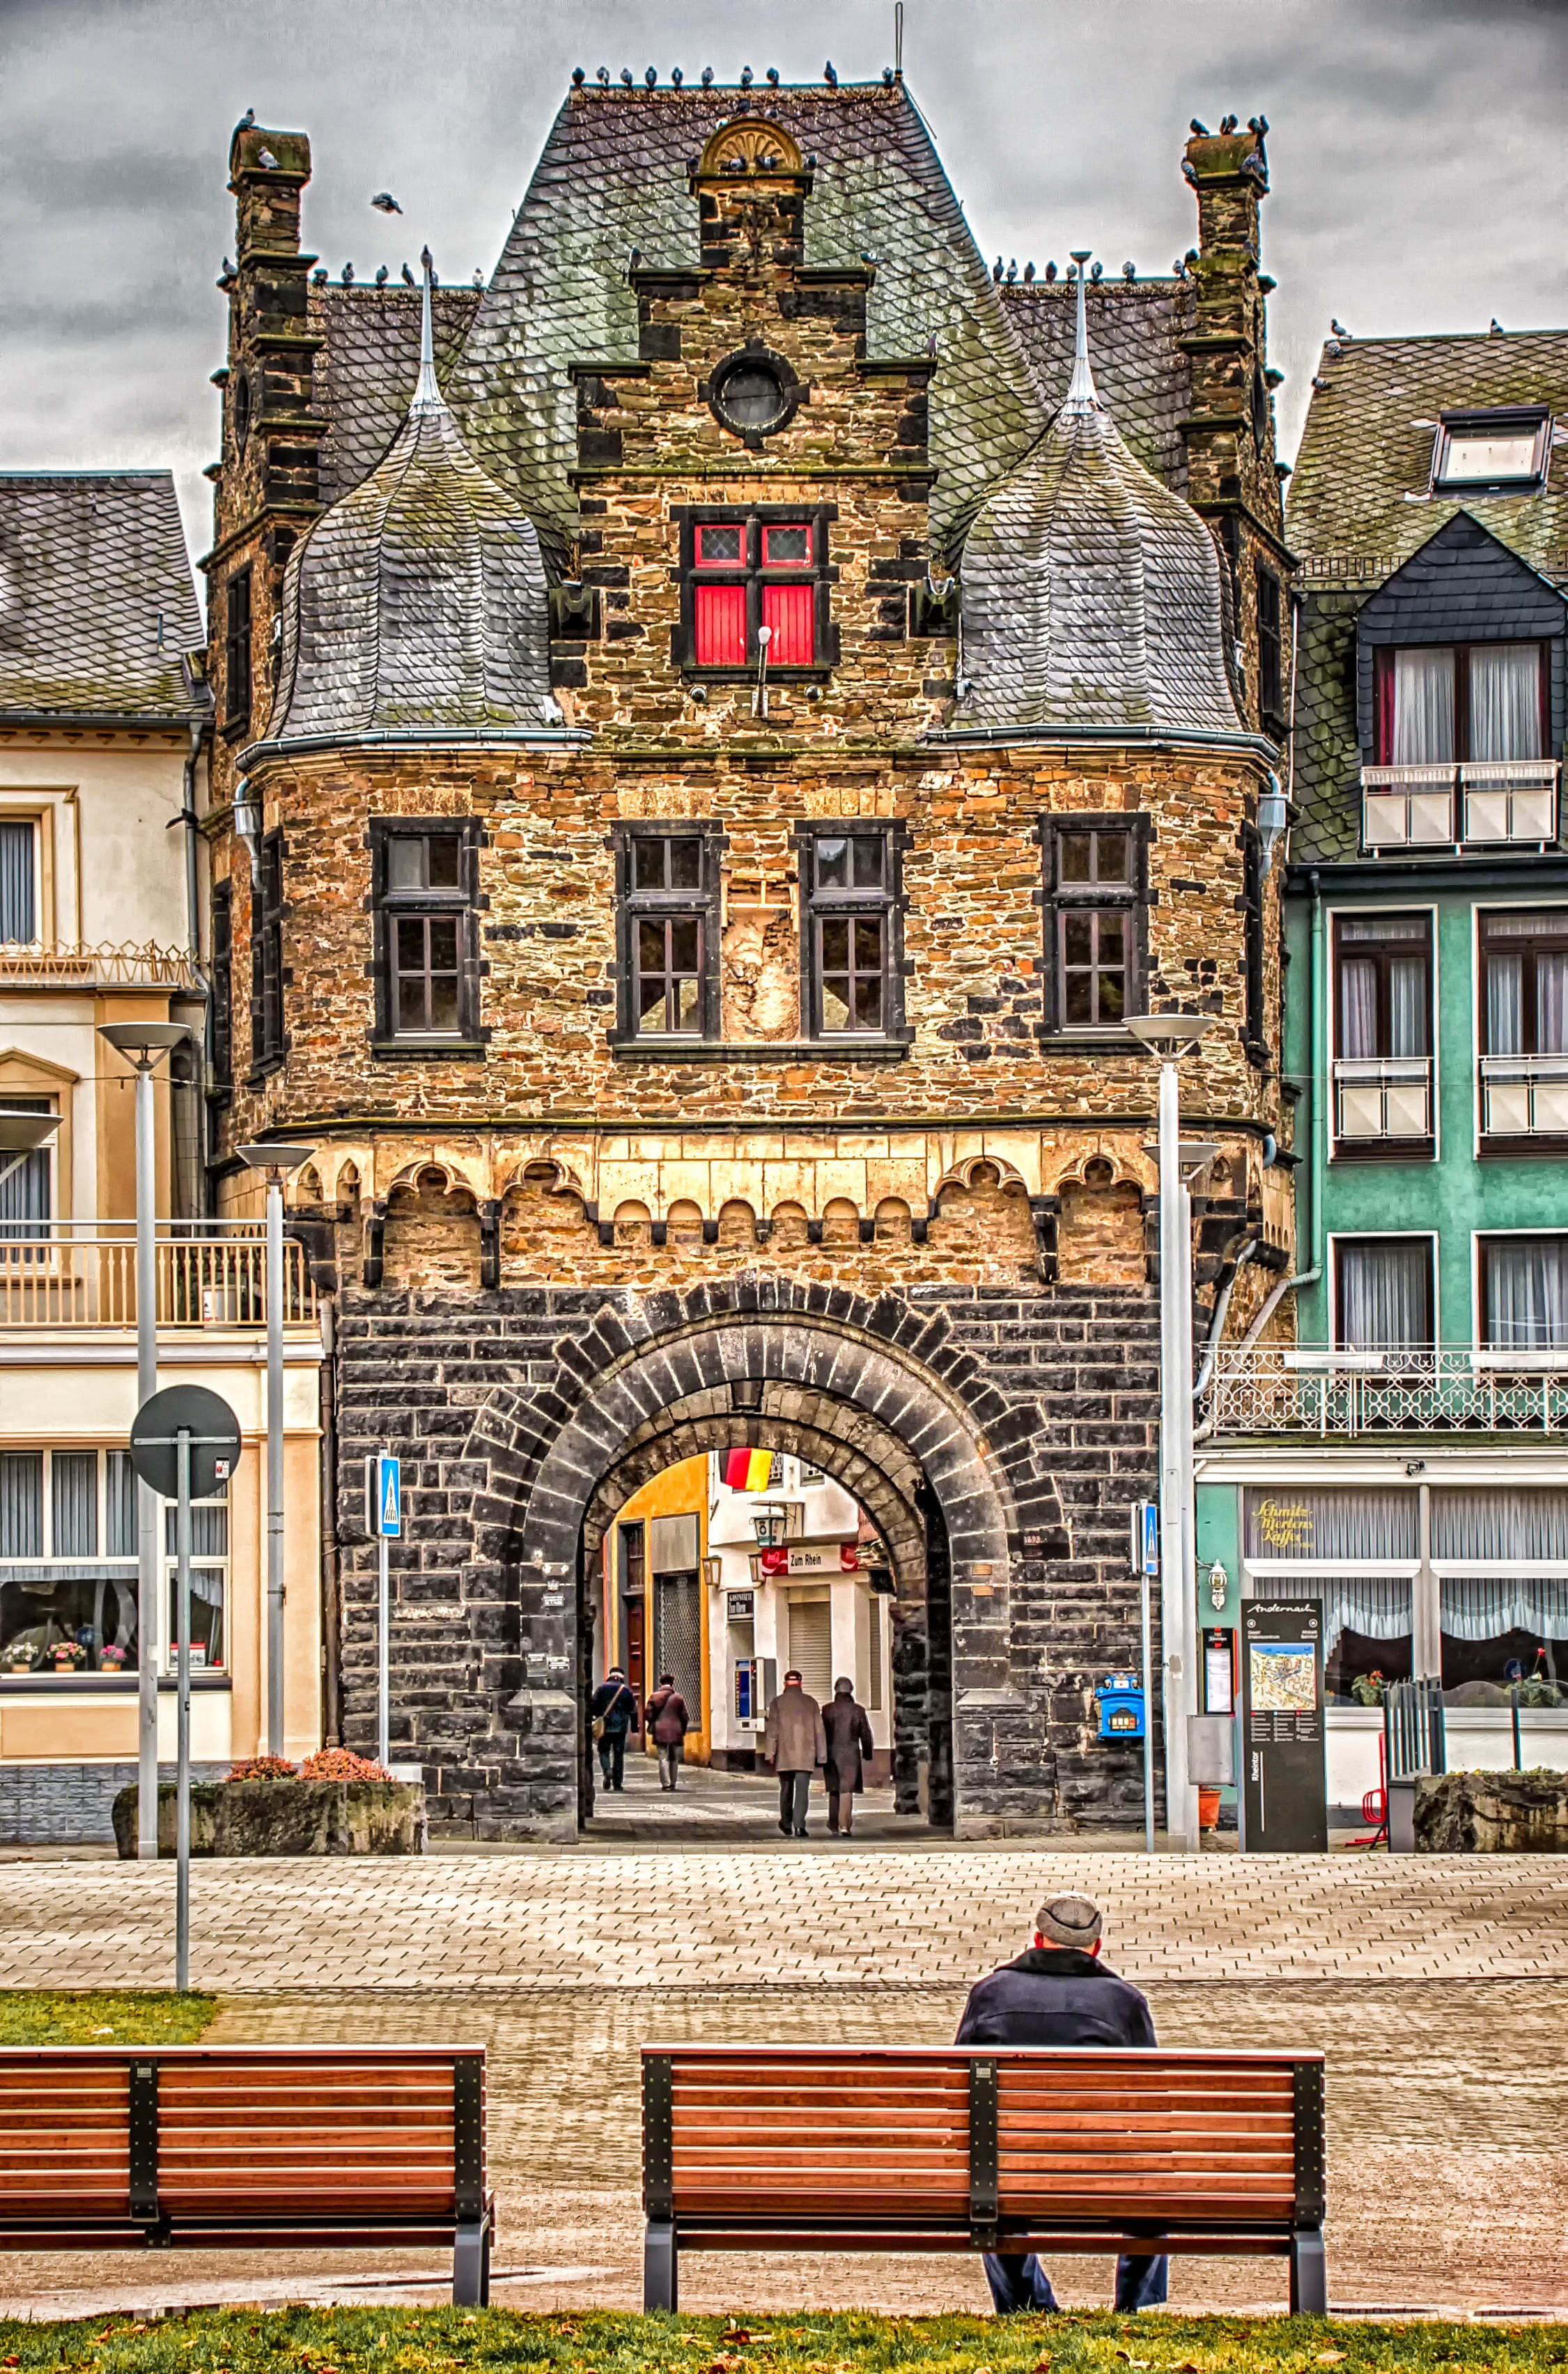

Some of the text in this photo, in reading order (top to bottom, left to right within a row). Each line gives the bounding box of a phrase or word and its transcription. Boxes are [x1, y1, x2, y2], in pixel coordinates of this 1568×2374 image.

[1252, 1499, 1312, 1517] Schmitz-
[1262, 1529, 1302, 1548] Kaffee
[791, 1555, 803, 1566] Zum
[805, 1553, 821, 1566] Rhein
[1247, 1603, 1317, 1613] Andernach
